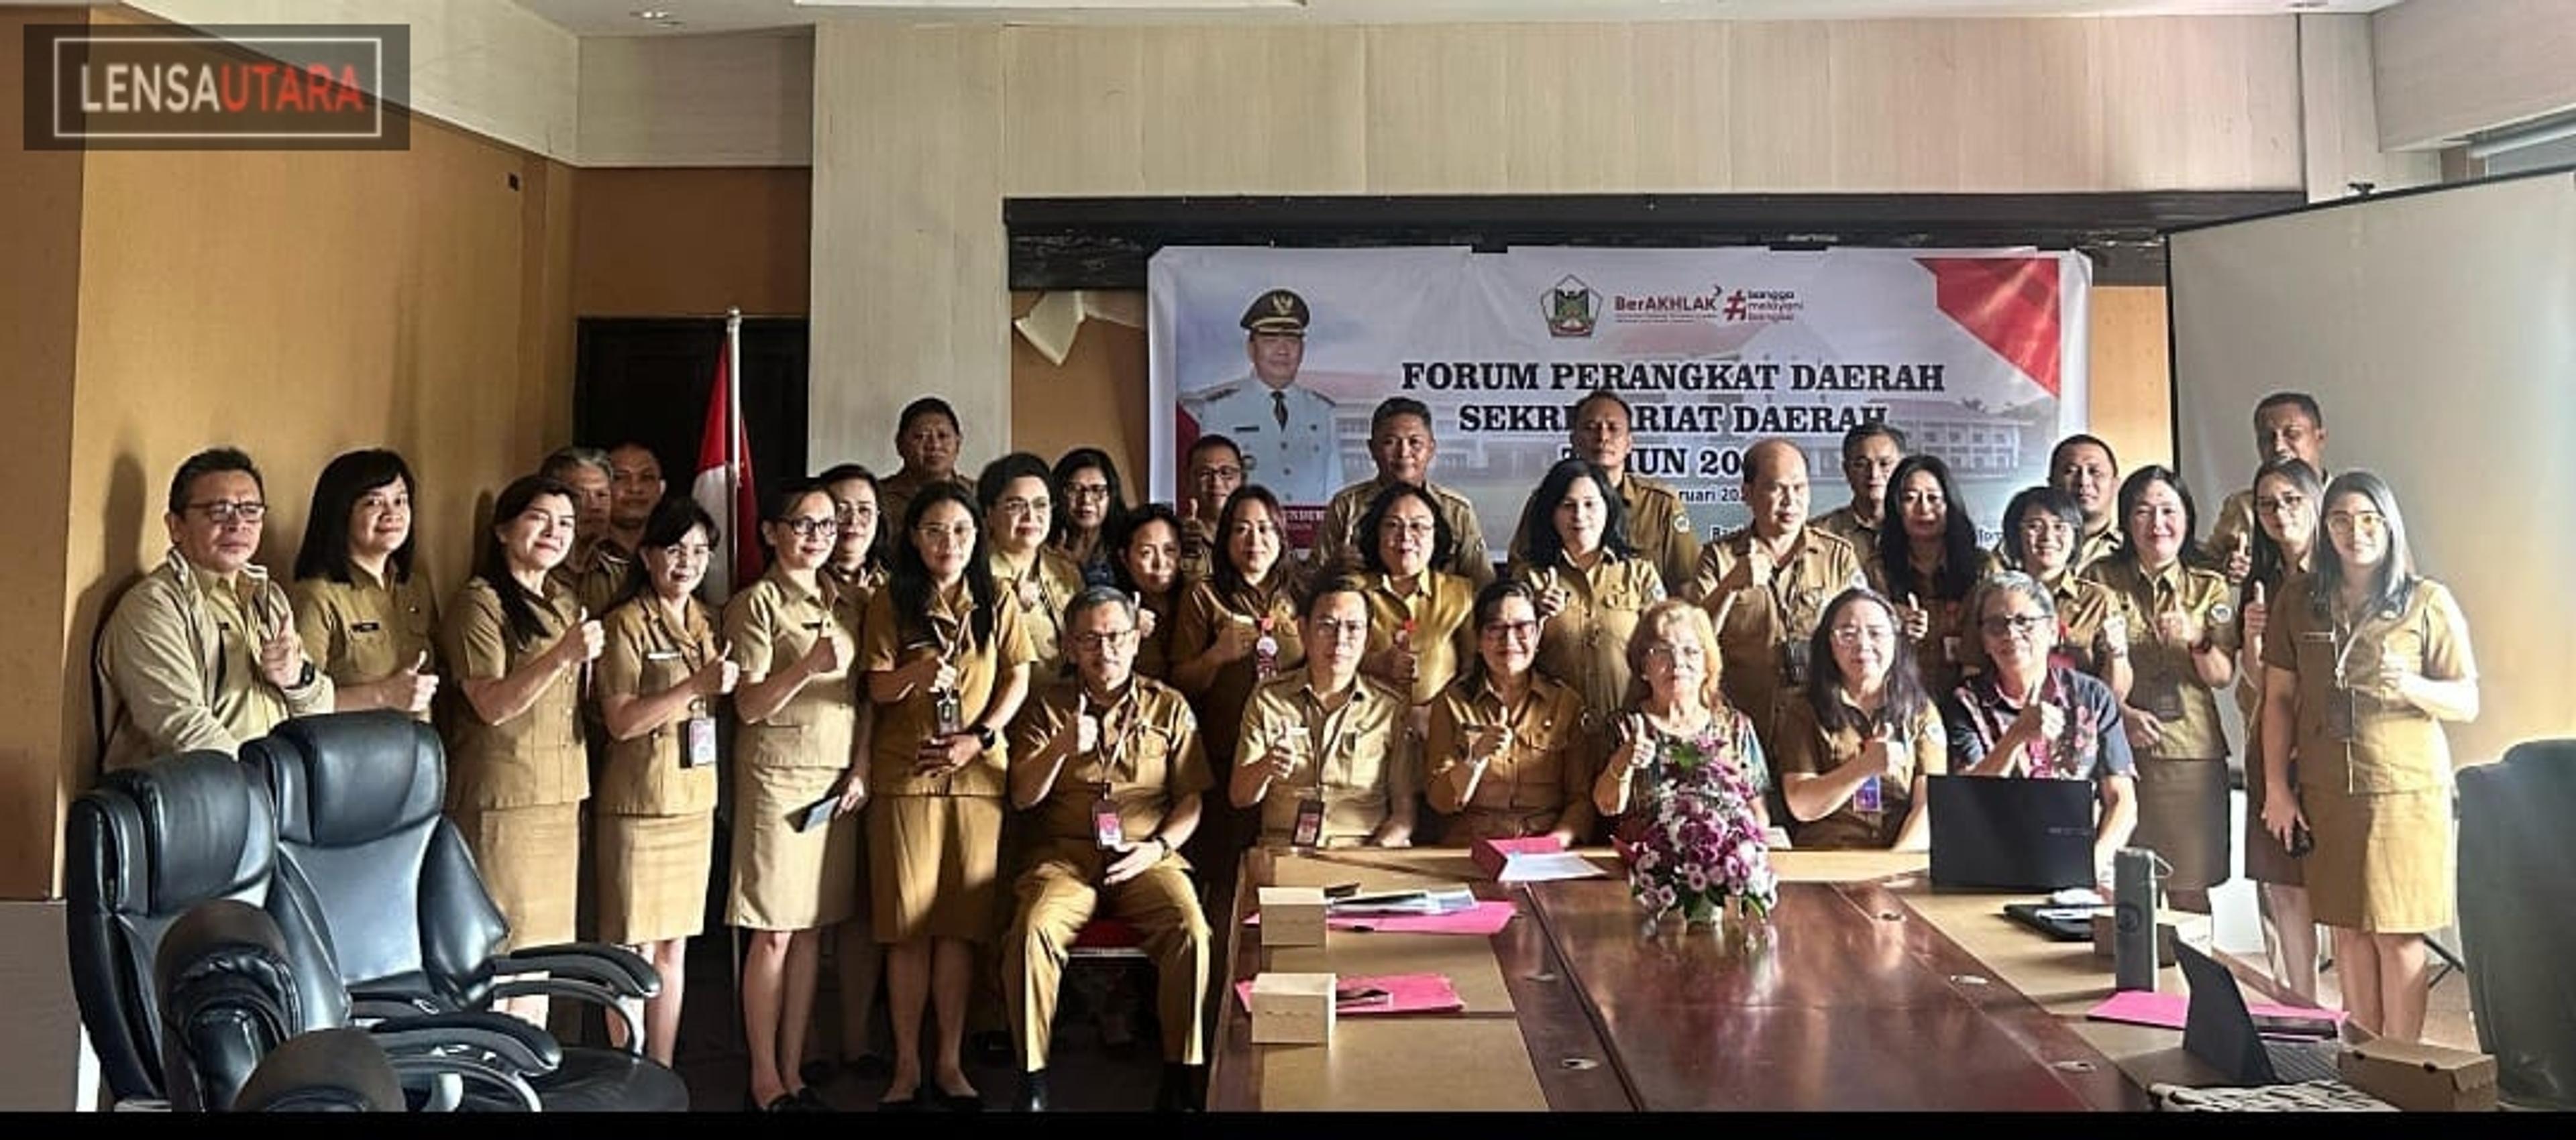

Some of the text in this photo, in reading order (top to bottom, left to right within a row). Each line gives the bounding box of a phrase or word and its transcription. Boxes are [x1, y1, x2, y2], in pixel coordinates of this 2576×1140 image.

[1614, 295, 1717, 311] BerAKHLAK
[1401, 362, 1945, 391] FORUM PERANGKAT DAERAH
